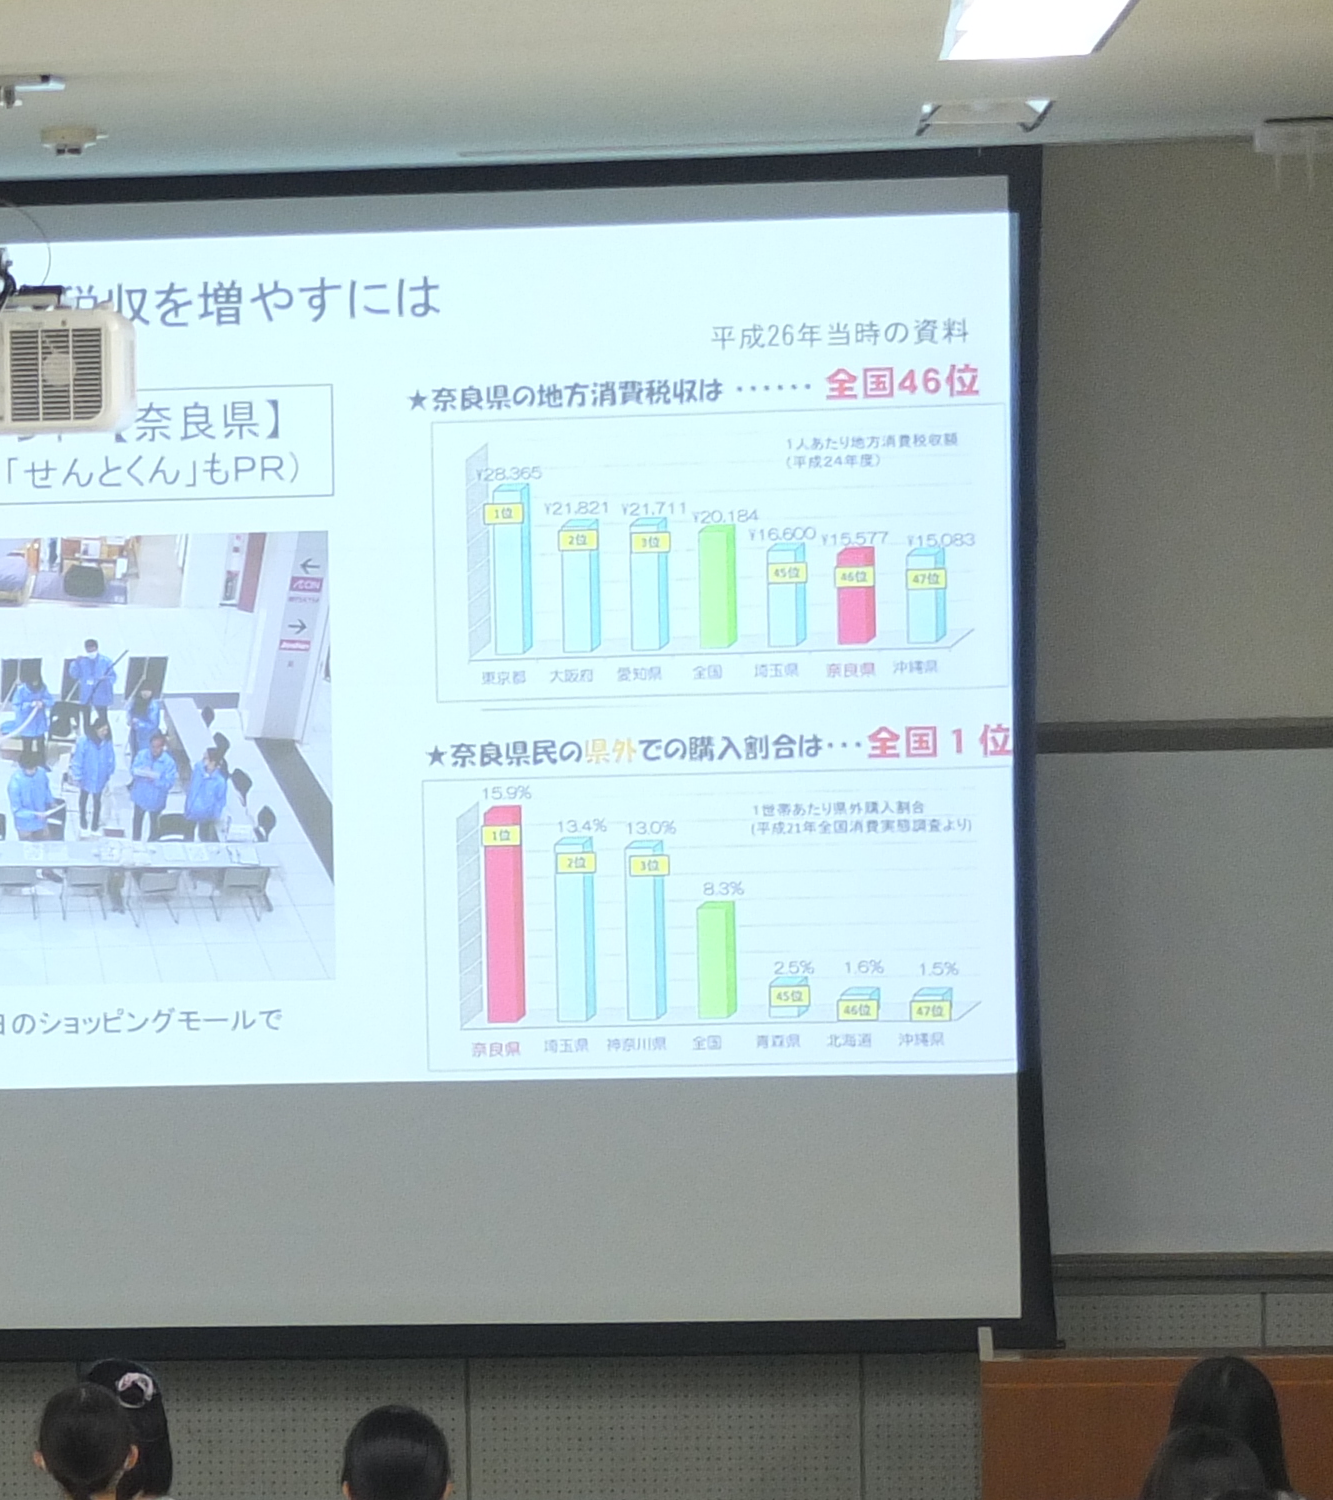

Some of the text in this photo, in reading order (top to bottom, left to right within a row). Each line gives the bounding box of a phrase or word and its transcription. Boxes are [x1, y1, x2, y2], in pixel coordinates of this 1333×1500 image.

[710, 318, 970, 351] 平成26年当時の資料
[825, 363, 980, 400] 全国46位
[549, 668, 594, 684] 大阪府
[616, 666, 663, 682] 愛知県
[692, 664, 723, 680] 全国
[826, 661, 876, 678] 奈良県
[481, 670, 527, 686] 東京都
[481, 785, 533, 801] 15.9%
[558, 818, 608, 834] 13.4%
[627, 820, 677, 836] 13.0%
[703, 881, 745, 896] 8.3%
[471, 1041, 522, 1058] 奈良県
[606, 1036, 667, 1052] 神奈川県
[692, 1035, 722, 1051] 全国
